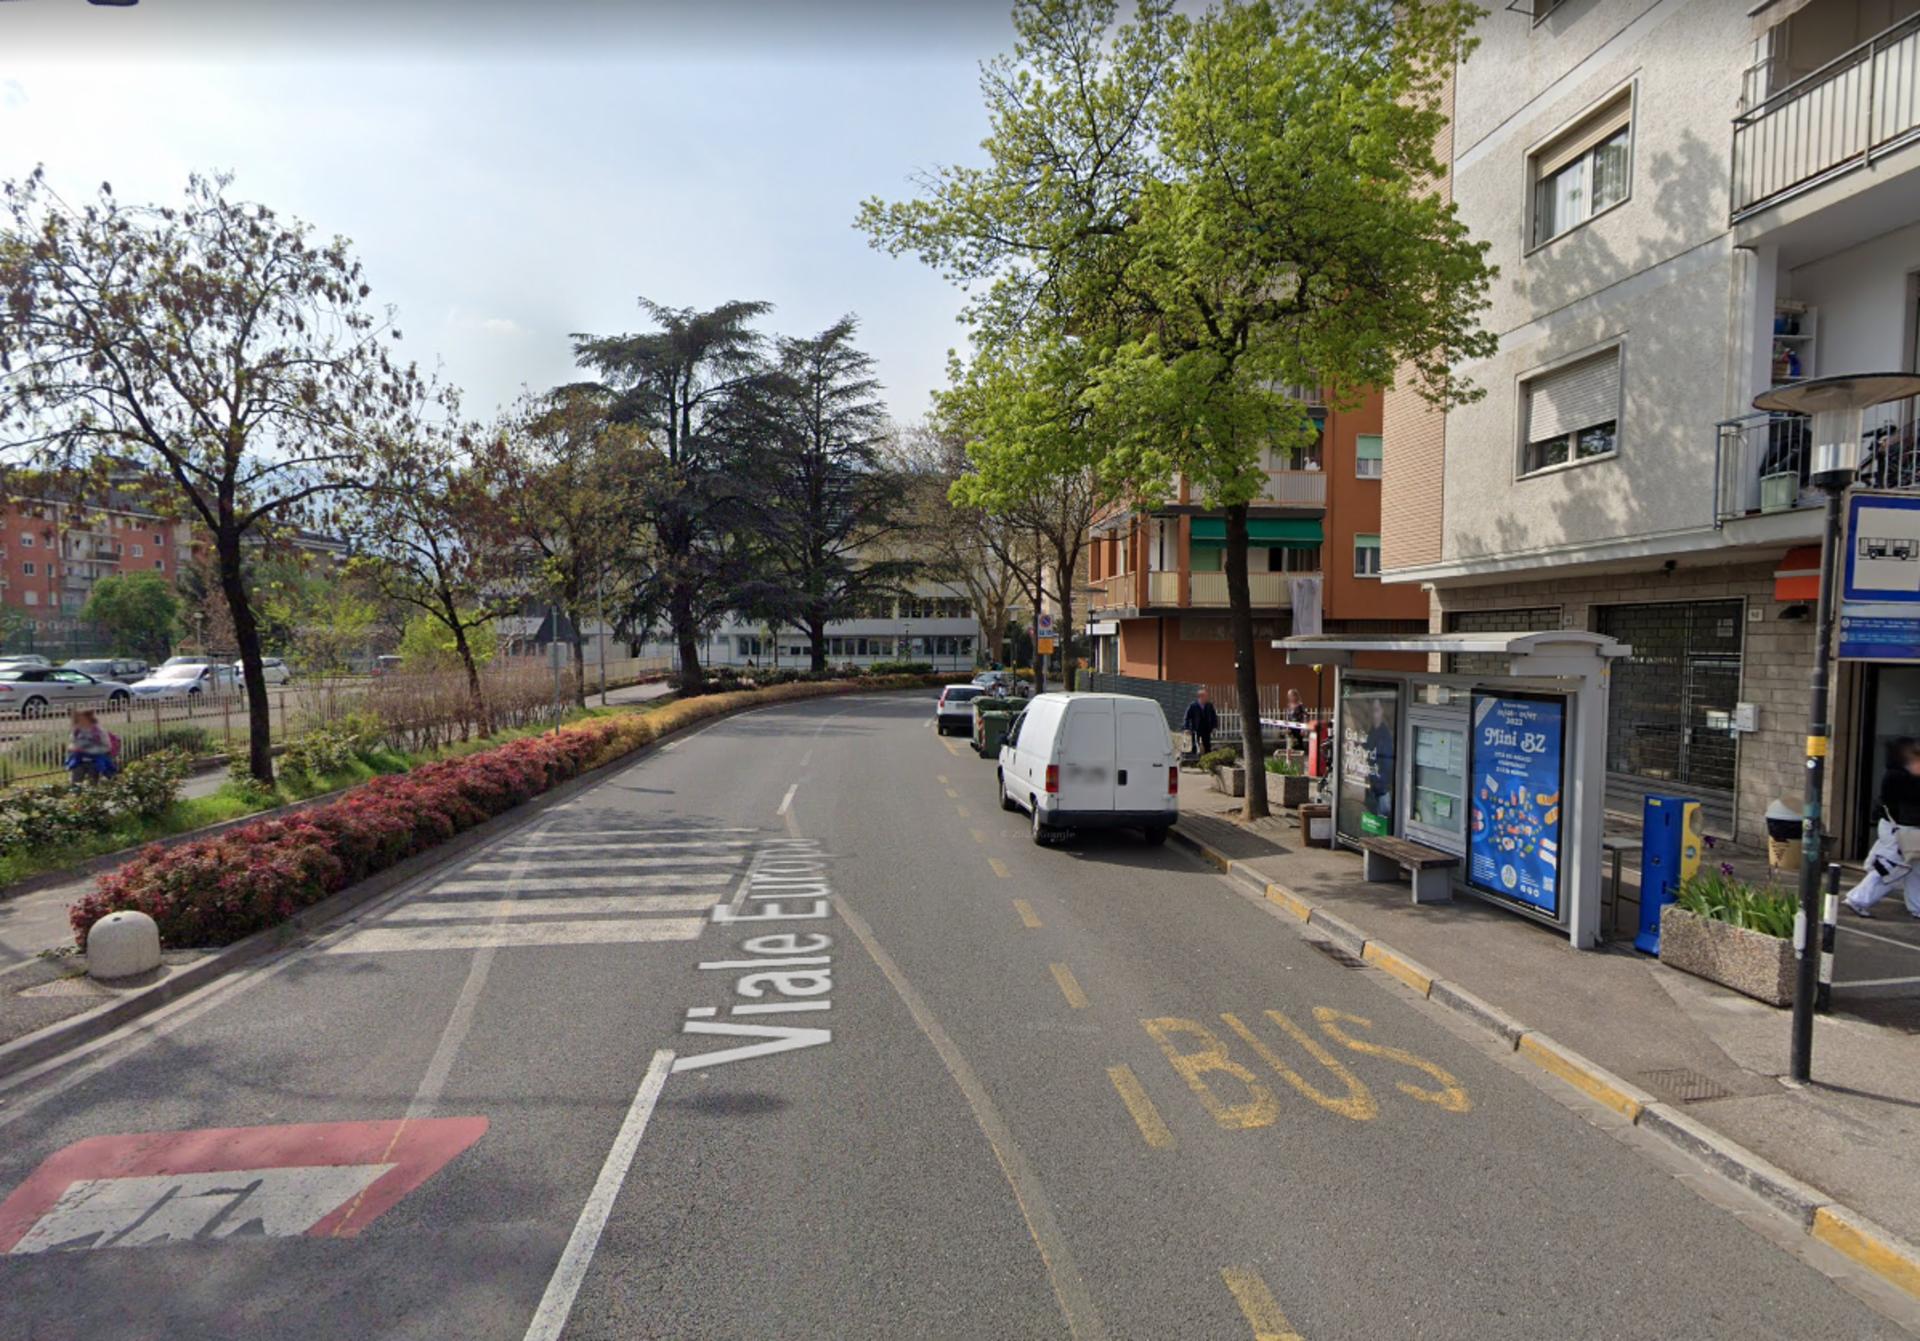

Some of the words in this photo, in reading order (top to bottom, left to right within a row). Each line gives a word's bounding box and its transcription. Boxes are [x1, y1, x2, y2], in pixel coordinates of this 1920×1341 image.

[1484, 727, 1518, 747] Mini
[1520, 732, 1547, 754] BZ
[1141, 1006, 1472, 1129] BUS
